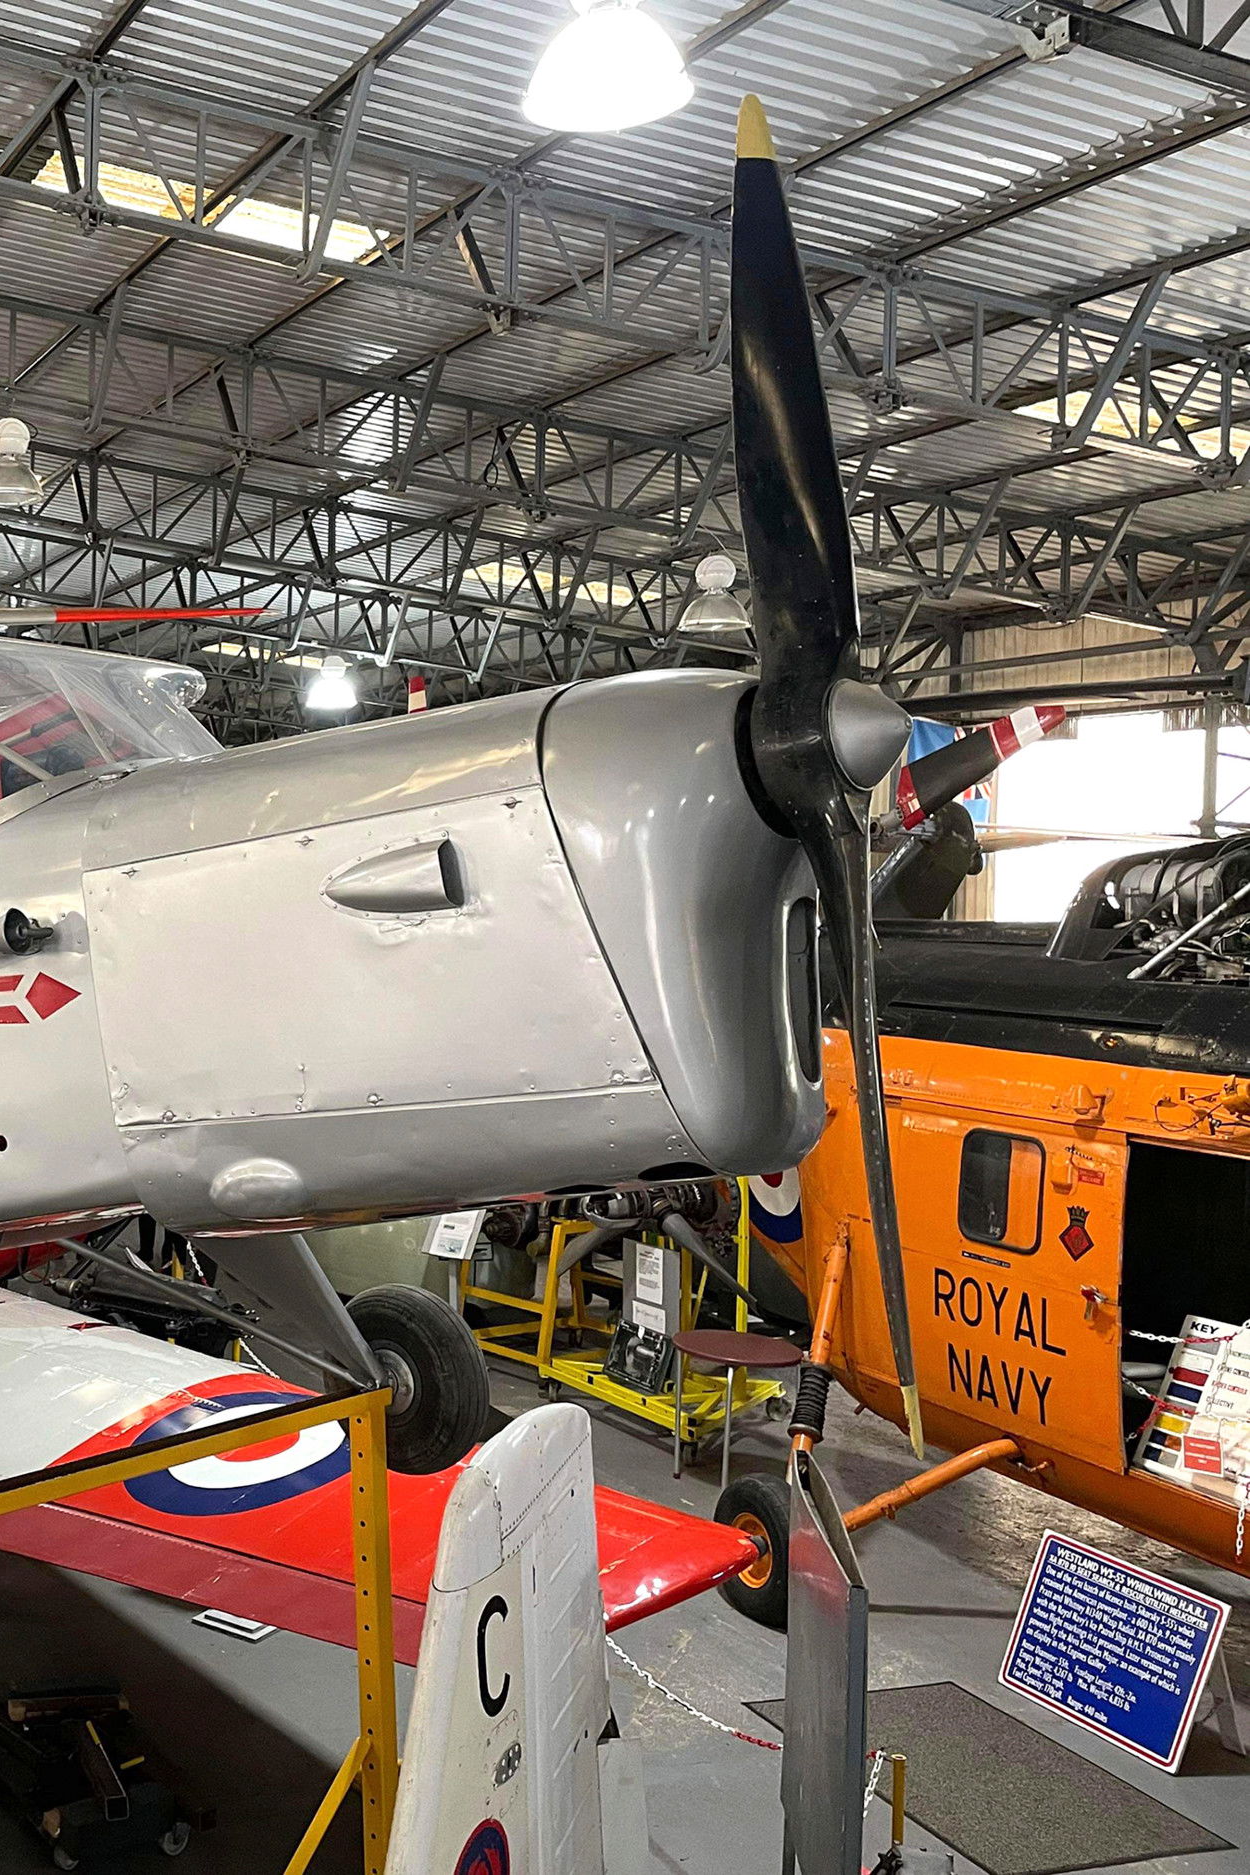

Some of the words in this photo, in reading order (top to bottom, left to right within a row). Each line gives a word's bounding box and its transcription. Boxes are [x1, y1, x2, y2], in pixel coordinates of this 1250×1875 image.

[934, 1267, 1067, 1357] ROYAL
[1190, 1321, 1219, 1335] KEY
[948, 1342, 1052, 1427] NAVY
[1045, 1564, 1057, 1577] One
[1062, 1572, 1072, 1584] the
[1071, 1576, 1084, 1589] first
[1082, 1581, 1099, 1596] batch
[1123, 1598, 1138, 1613] built
[1136, 1604, 1161, 1625] Sikorsky
[1178, 1625, 1196, 1639] which
[1057, 1546, 1100, 1573] WESTLAND
[1100, 1564, 1127, 1584] WS-55
[1126, 1576, 1179, 1607] WHIRLWIND
[1057, 1557, 1070, 1570] 870
[1075, 1566, 1092, 1579] SEAT
[1090, 1572, 1116, 1590] SEARCH
[1168, 1606, 1209, 1631] HELICOPTER
[1036, 1597, 1049, 1608] with
[1047, 1601, 1058, 1612] the
[1057, 1604, 1073, 1619] Royal
[1097, 1623, 1116, 1639] Patrol
[1114, 1631, 1127, 1647] Ship
[1038, 1584, 1053, 1598] Pratt
[1052, 1593, 1065, 1603] and
[1063, 1595, 1086, 1615] Whitney
[1102, 1613, 1118, 1630] Wasp
[1156, 1641, 1177, 1655] served
[1175, 1649, 1197, 1666] mainly
[1057, 1641, 1068, 1653] the
[1063, 1585, 1073, 1596] the
[1072, 1588, 1098, 1607] American
[1169, 1634, 1193, 1650] cylinder
[477, 1595, 511, 1717] C
[1057, 1629, 1068, 1641] the
[1127, 1664, 1152, 1681] example
[1157, 1678, 1175, 1692] which
